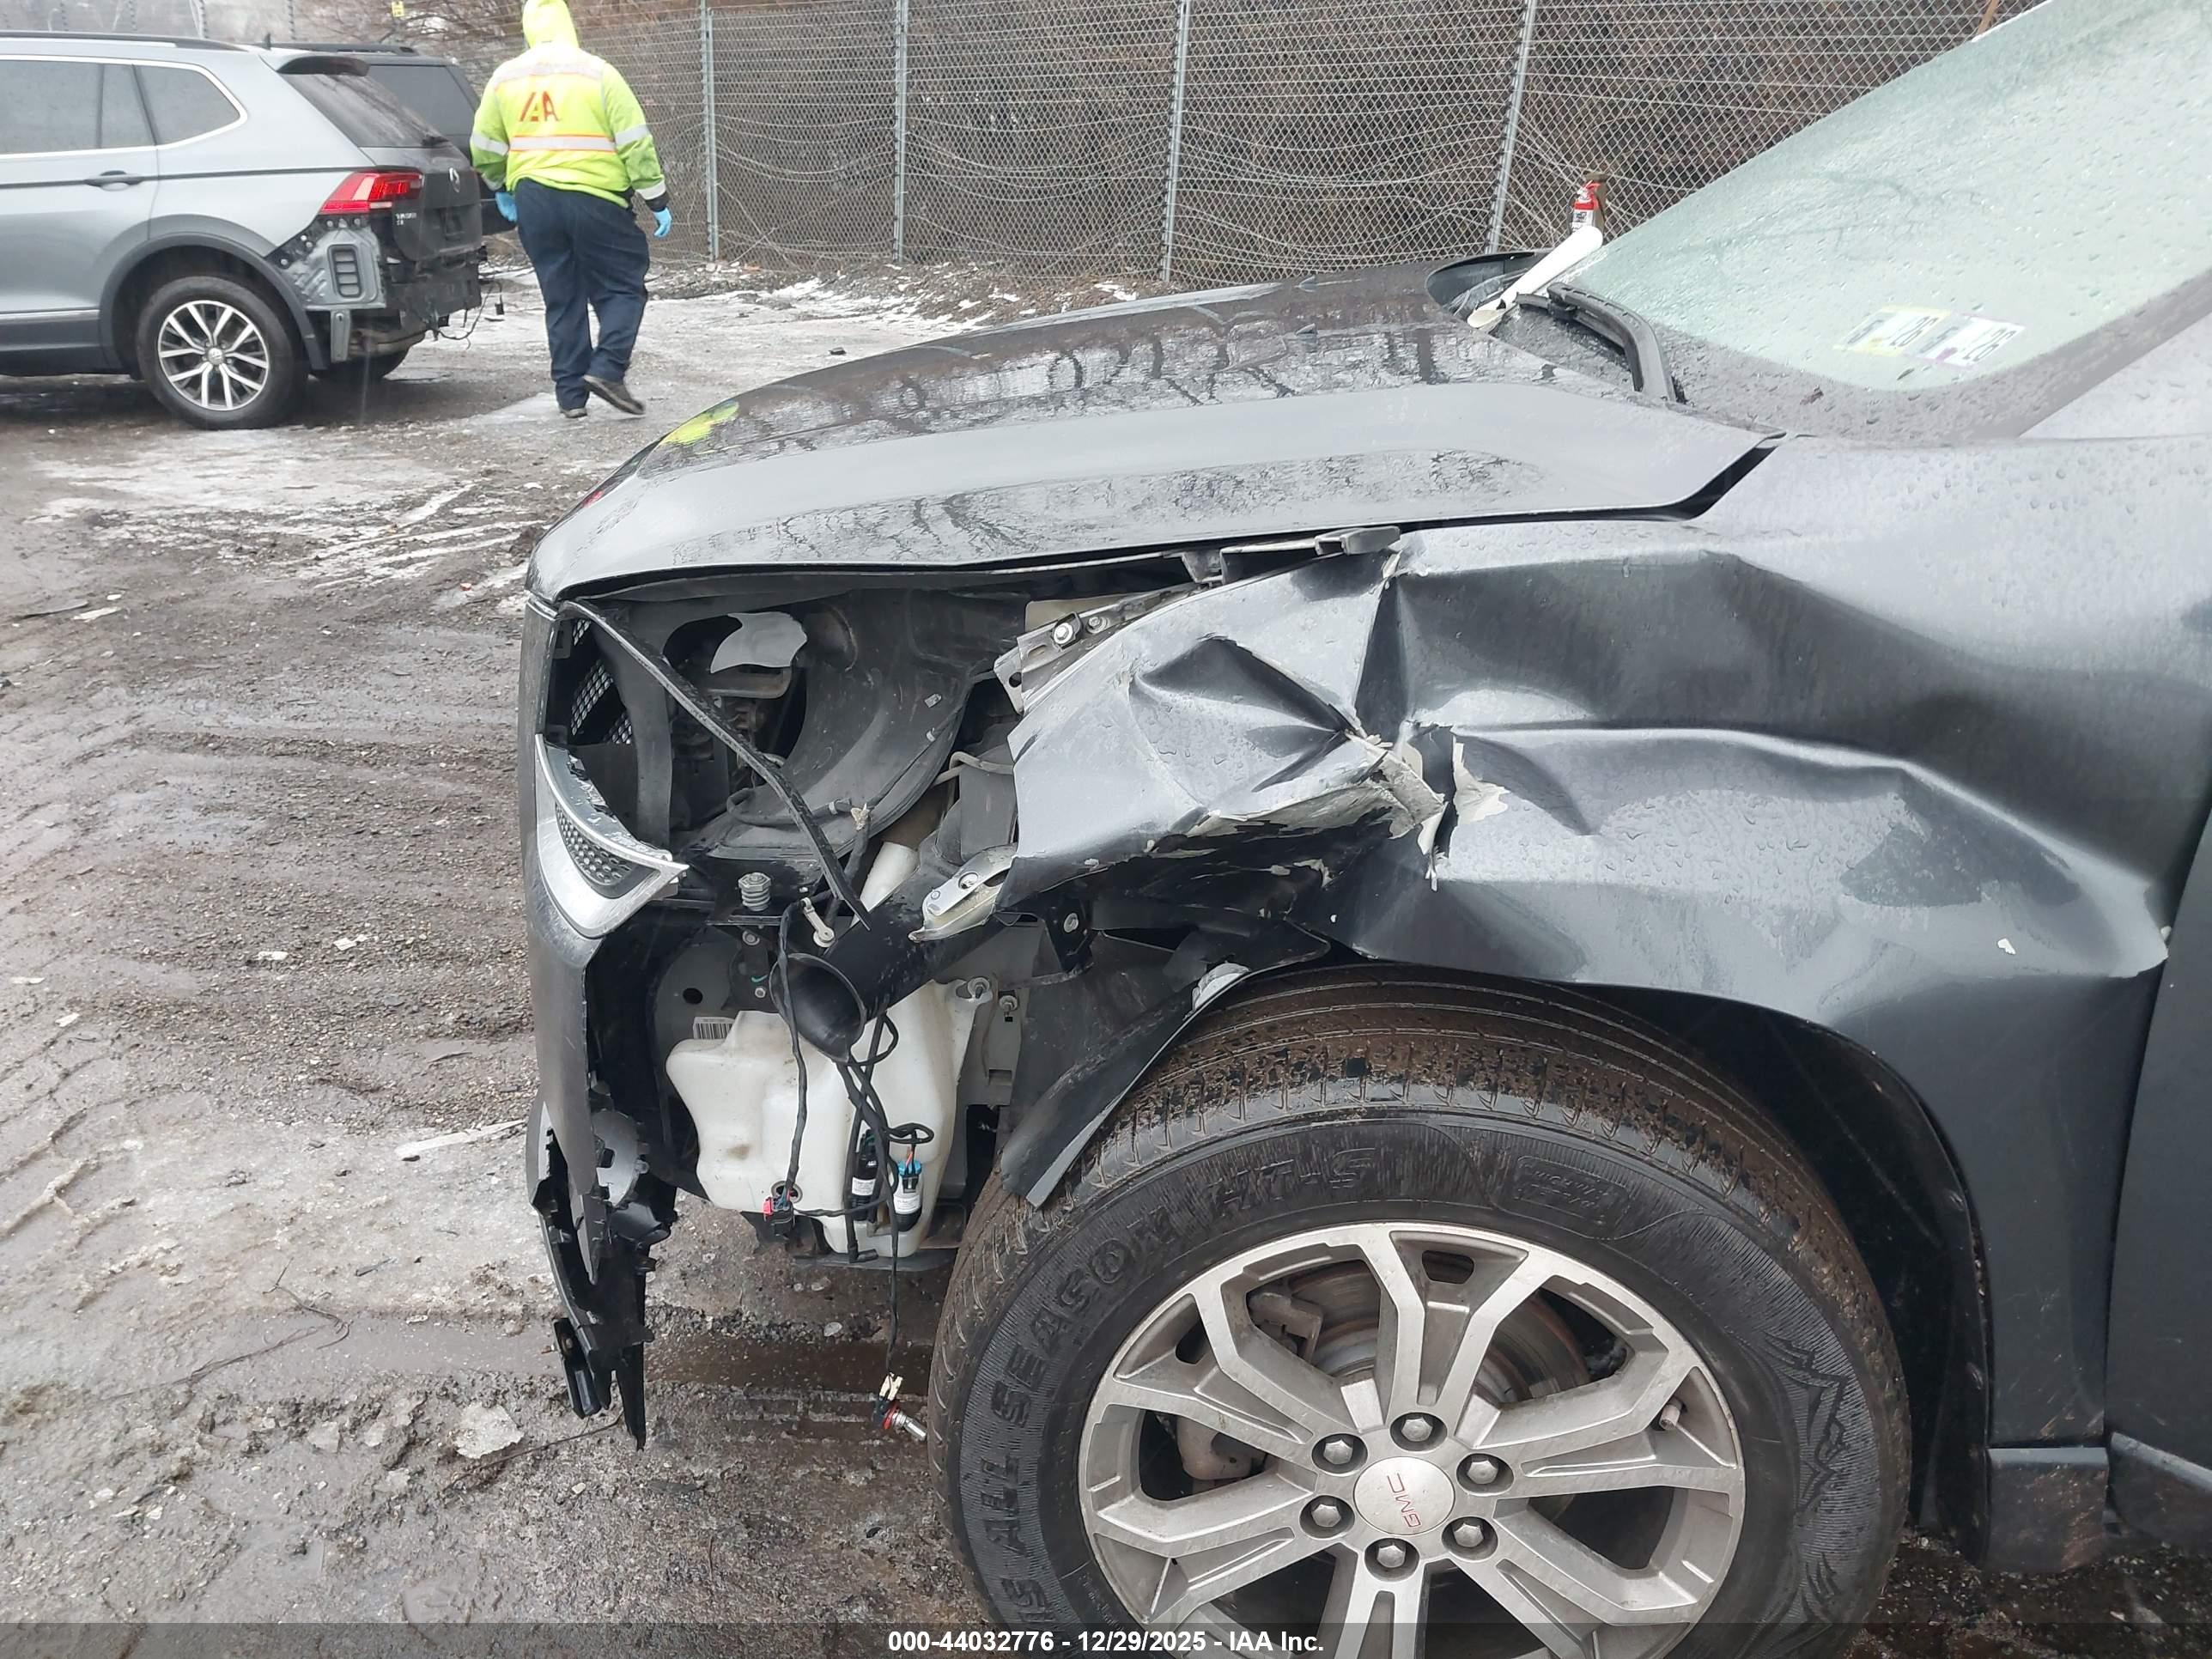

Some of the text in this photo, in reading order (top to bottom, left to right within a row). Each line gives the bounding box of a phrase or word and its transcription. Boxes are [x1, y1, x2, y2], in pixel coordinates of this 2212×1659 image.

[1890, 316, 1939, 347] 26
[1962, 327, 2018, 362] 26
[980, 1455, 1032, 1558] ALL
[1386, 1472, 1421, 1528] GMC
